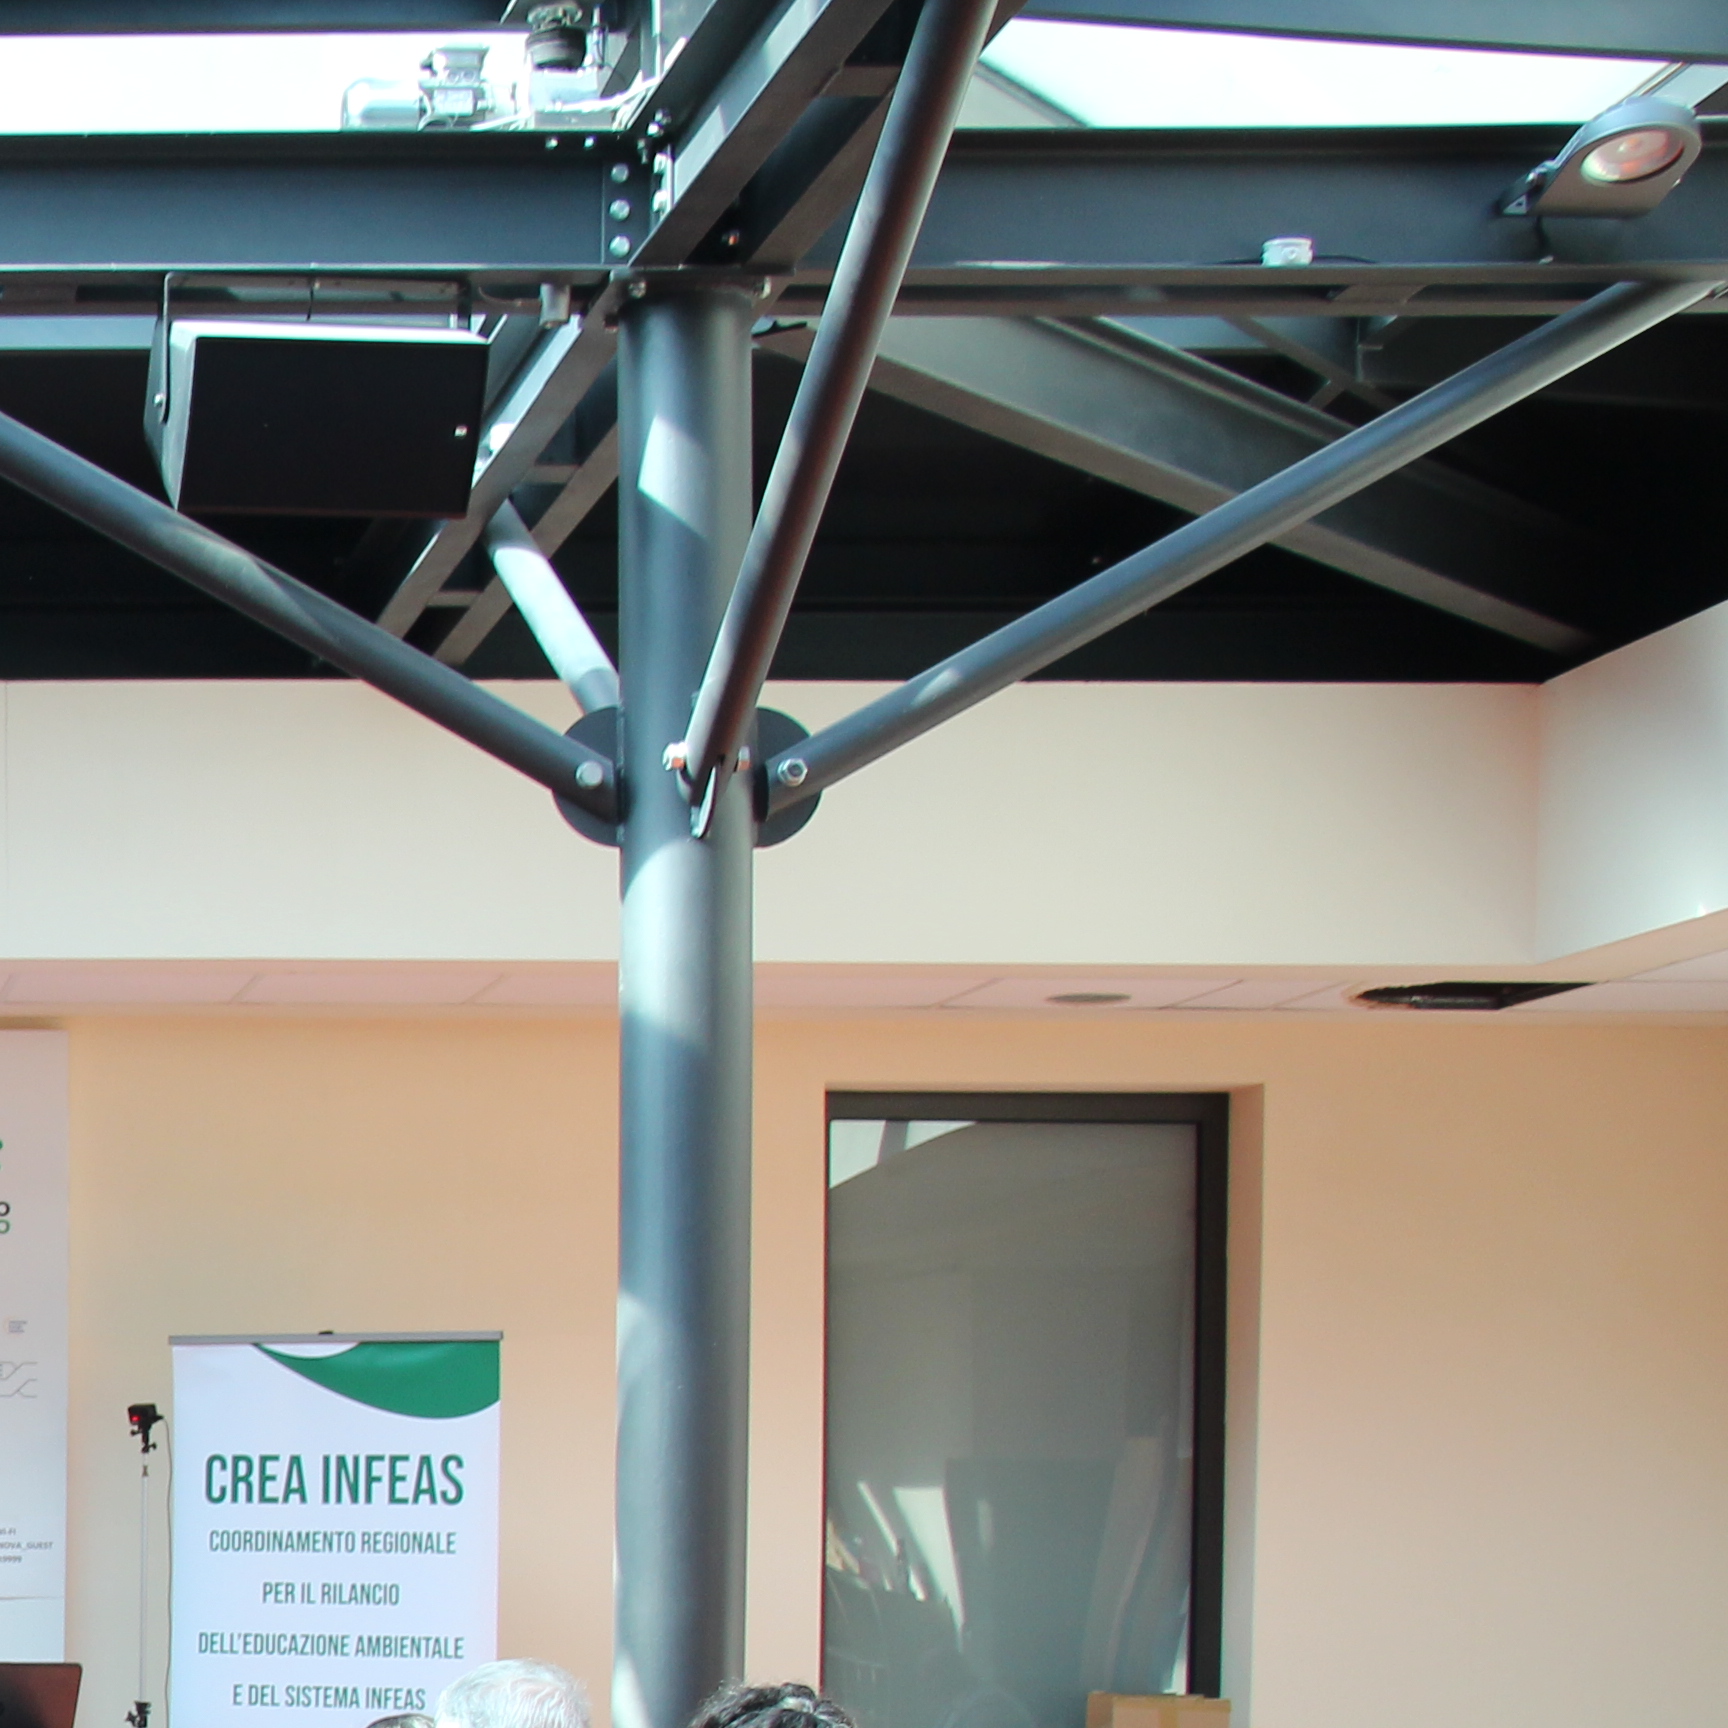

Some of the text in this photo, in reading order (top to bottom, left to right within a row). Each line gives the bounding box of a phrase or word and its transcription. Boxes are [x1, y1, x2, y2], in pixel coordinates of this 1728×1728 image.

[205, 1454, 465, 1506] CREA INFEAS
[209, 1529, 457, 1555] COORDINAMENTO REGIONALE
[262, 1581, 400, 1606] PER IL RILANCIO
[198, 1631, 465, 1660] DELL'EDUCAZIONE AMBIENTALE
[232, 1683, 426, 1711] E DEL SISTEMA INFEAS
